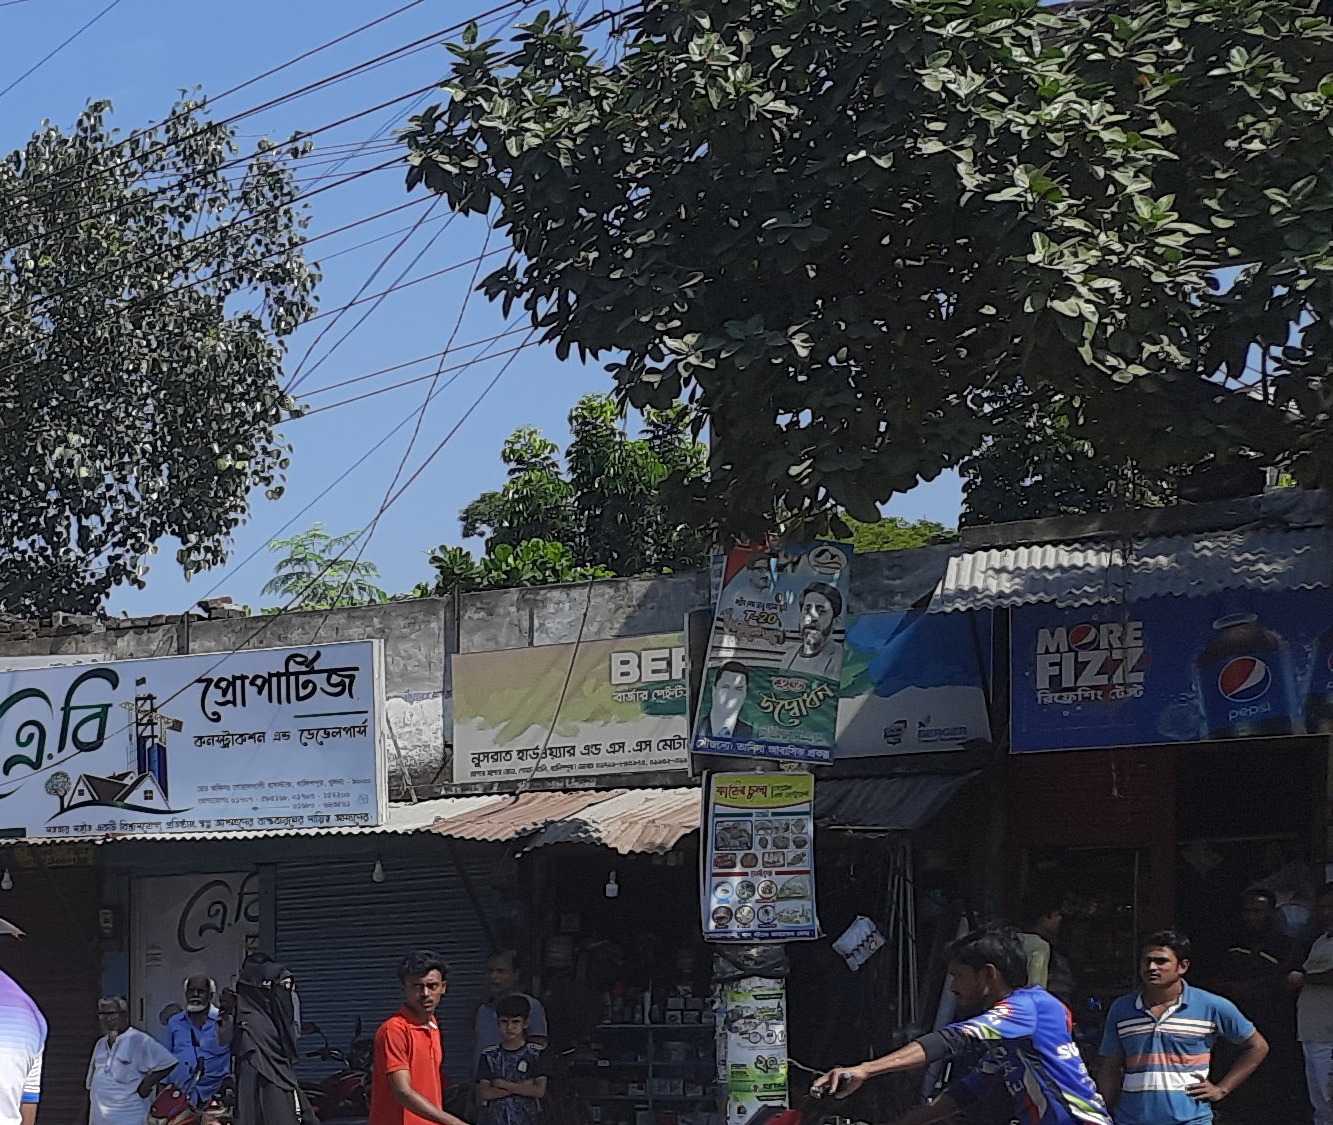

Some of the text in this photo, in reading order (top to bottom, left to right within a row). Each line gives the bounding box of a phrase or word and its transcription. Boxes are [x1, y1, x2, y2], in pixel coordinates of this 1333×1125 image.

[744, 610, 778, 624] T-20
[1036, 648, 1144, 690] FIZZ
[196, 650, 359, 723] প্রোপার্টিজ
[613, 689, 648, 702] বার্জার
[759, 683, 834, 726] উদ্বোধন
[1228, 702, 1272, 721] pepsi
[470, 751, 512, 769] নুসরাত
